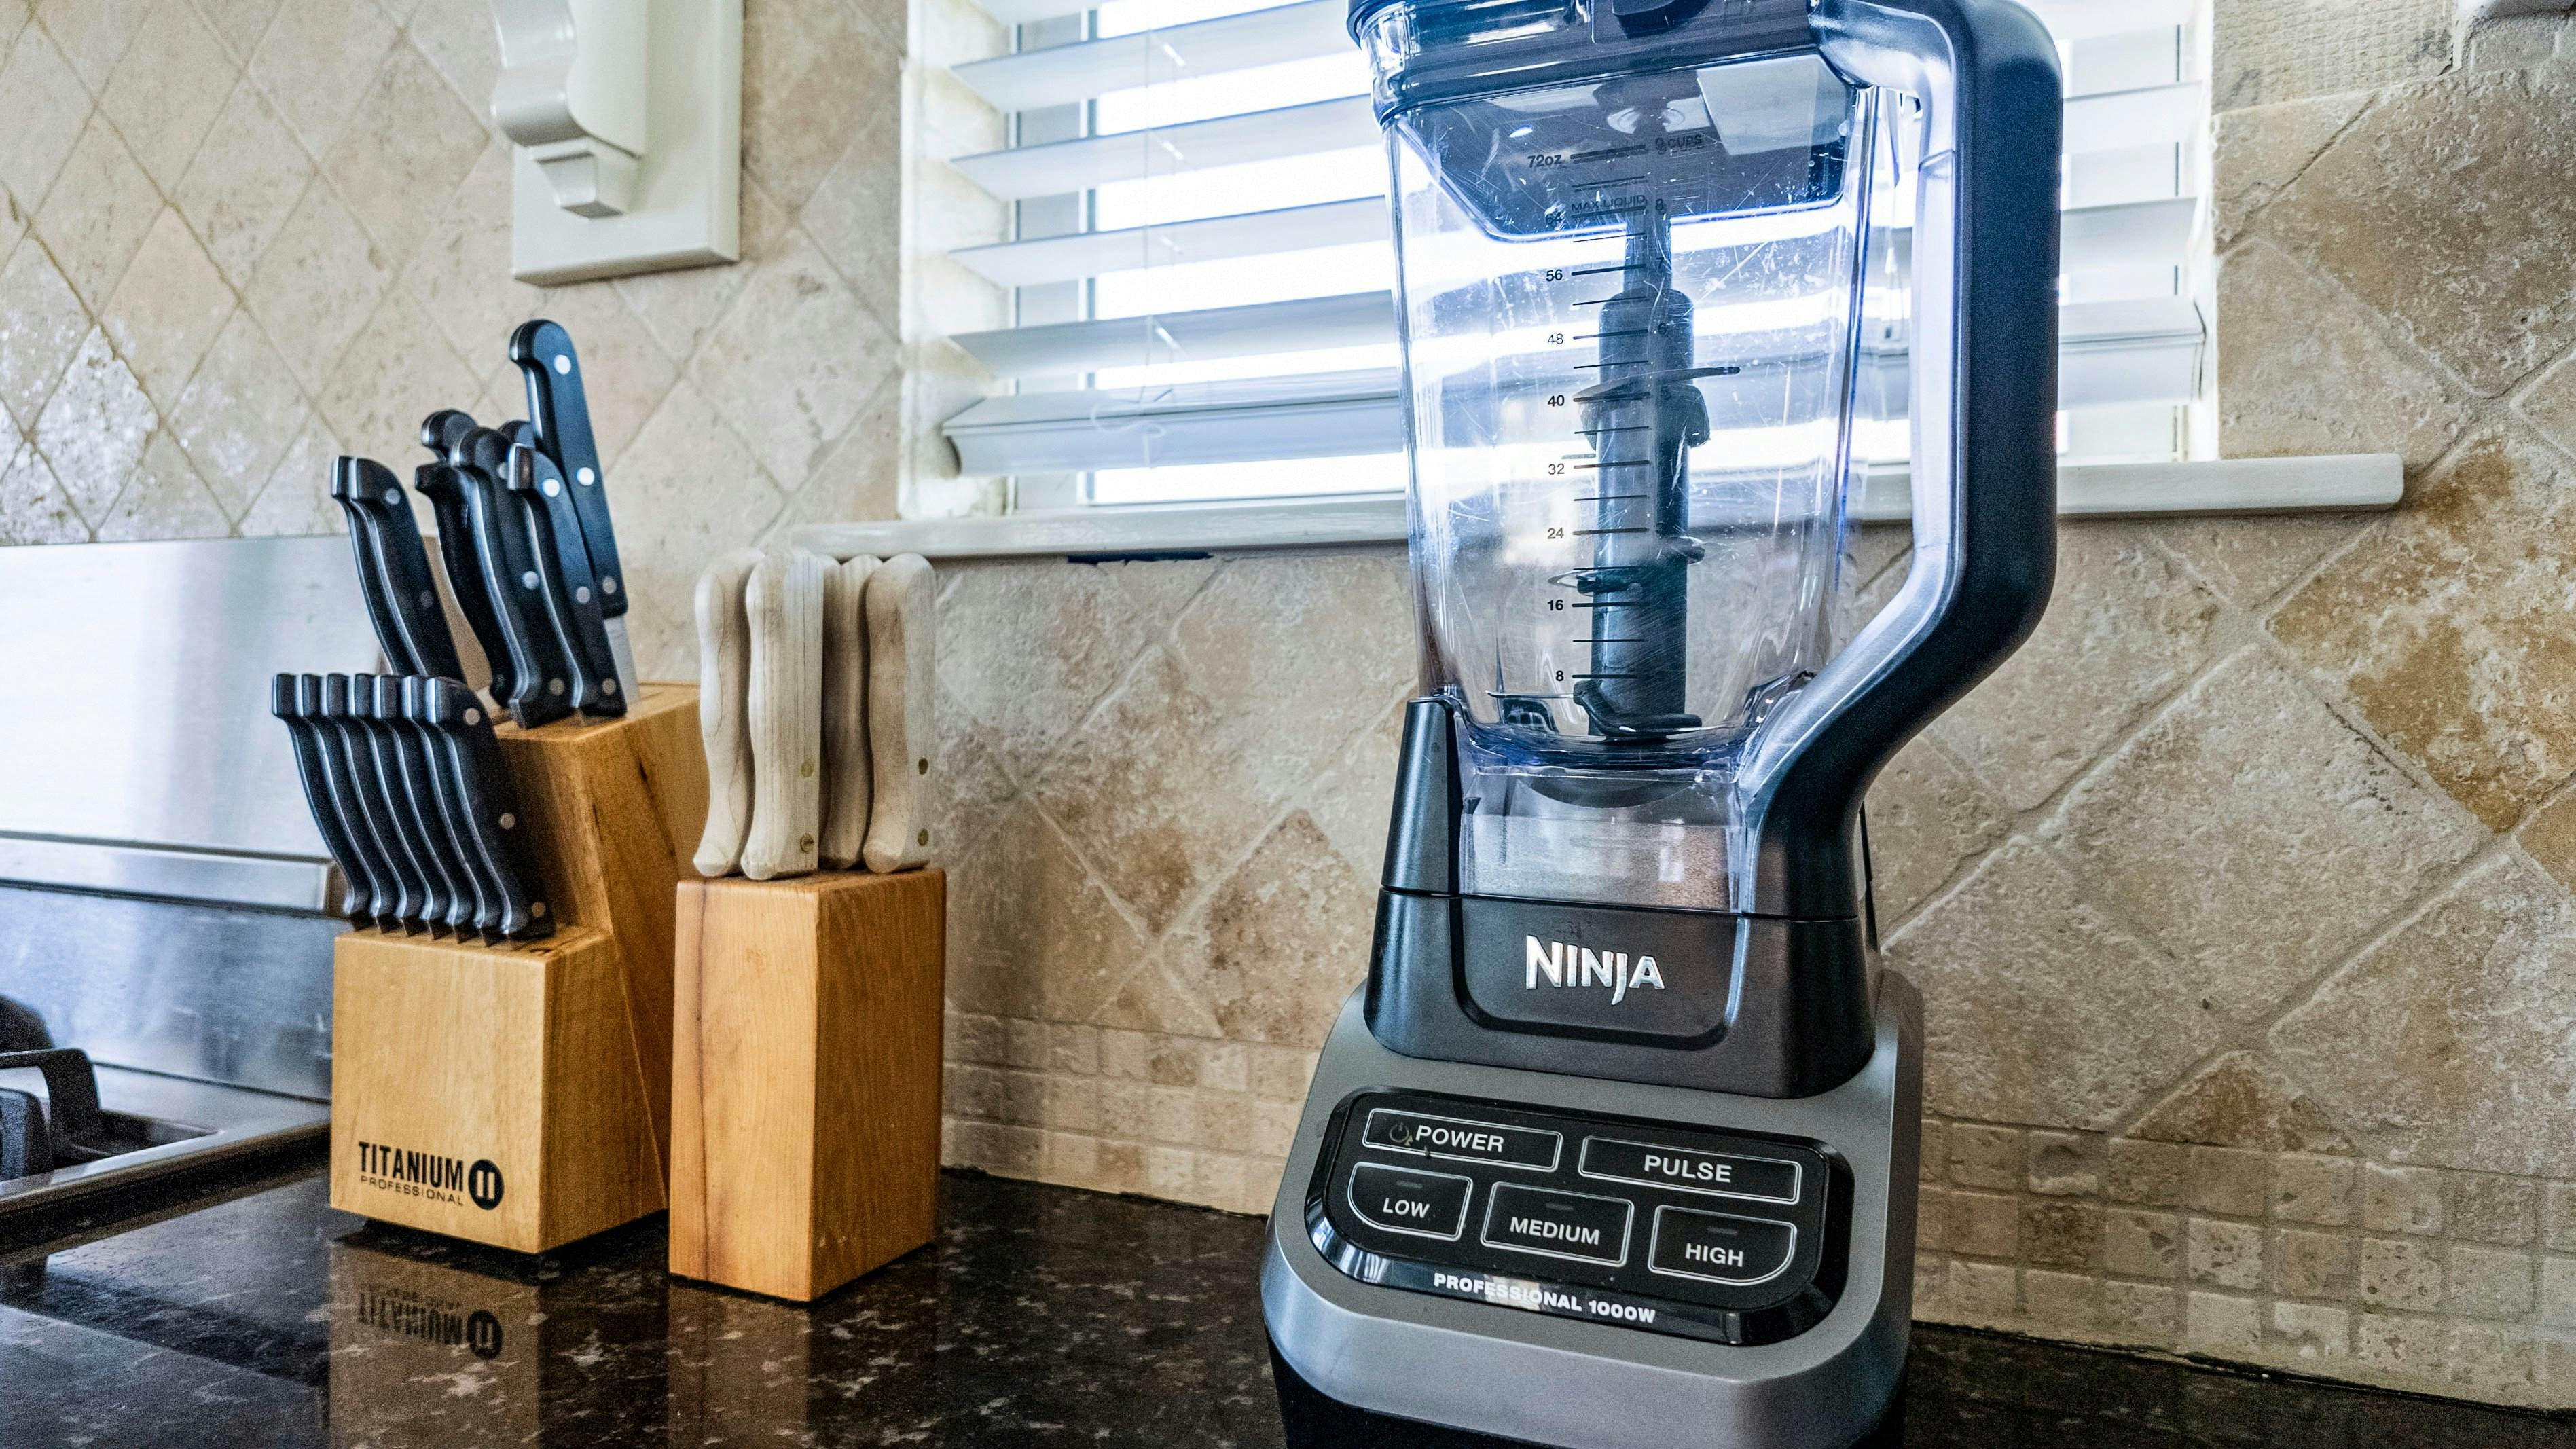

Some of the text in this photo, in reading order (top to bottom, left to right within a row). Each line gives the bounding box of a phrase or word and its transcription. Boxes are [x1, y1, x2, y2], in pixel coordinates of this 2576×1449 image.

[1546, 270, 1563, 282] 56
[1547, 333, 1564, 346] 48
[1548, 395, 1565, 407] 40
[1548, 463, 1565, 475] 32
[1547, 528, 1565, 540] 24
[1547, 599, 1564, 611] 16
[1555, 670, 1564, 682] 8
[1525, 935, 1665, 1006] NINJA
[1415, 1125, 1504, 1152] POWER
[359, 1141, 464, 1192] TITANIUM
[1644, 1154, 1732, 1184] PULSE
[361, 1175, 464, 1206] PROFESSIONAL
[1382, 1196, 1430, 1219] LOW
[1509, 1216, 1601, 1246] MEDIUM
[1684, 1242, 1744, 1268] HIGH
[1434, 1272, 1656, 1323] PROFESSIONAL 1000W
